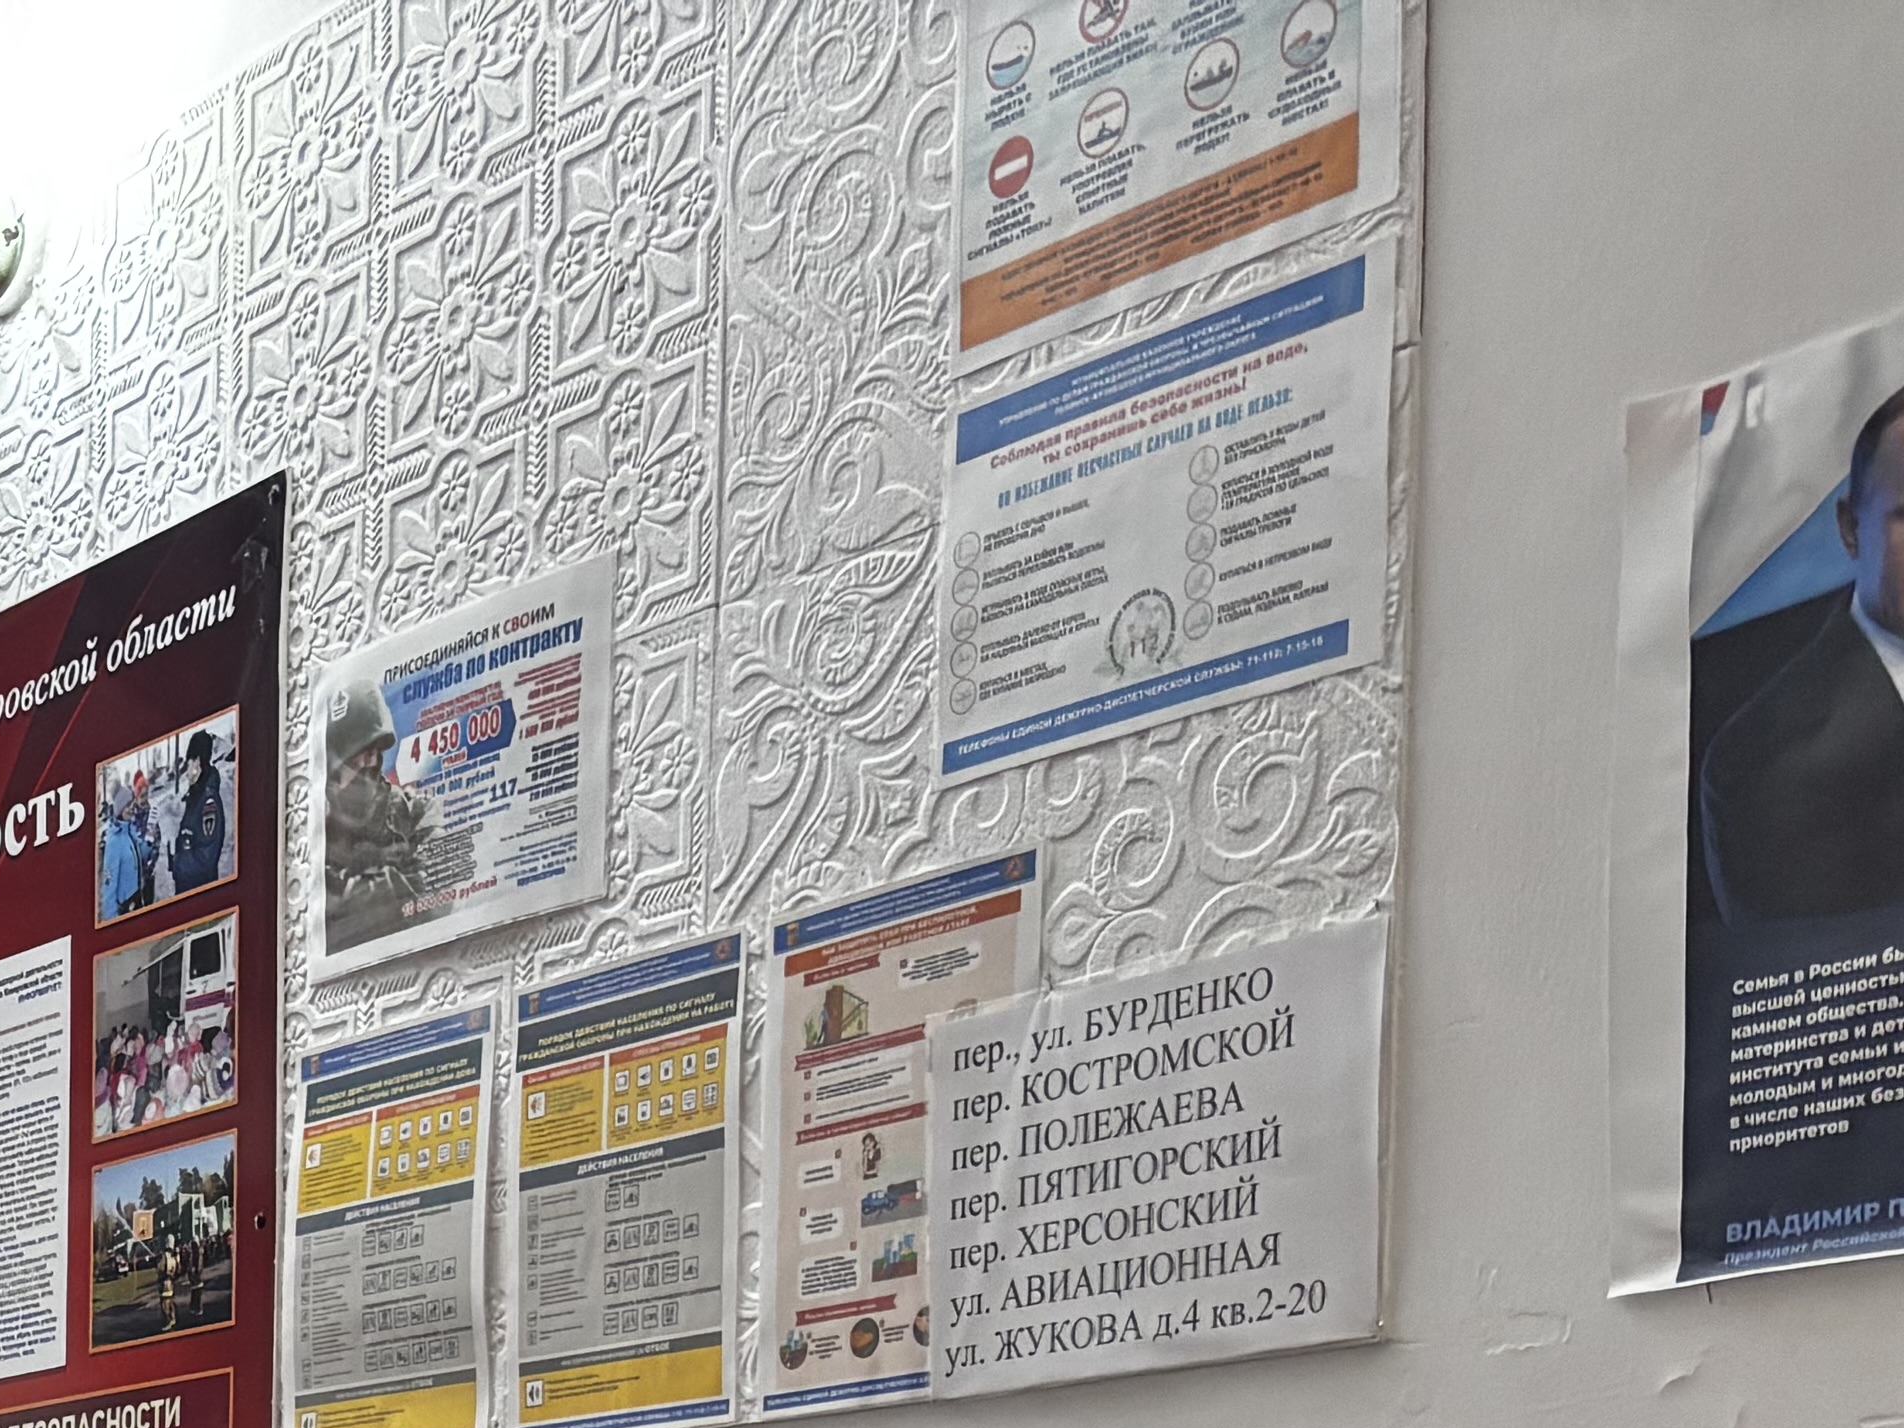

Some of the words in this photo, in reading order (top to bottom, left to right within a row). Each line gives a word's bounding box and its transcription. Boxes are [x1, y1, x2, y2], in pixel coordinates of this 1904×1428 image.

[991, 432, 1062, 470] Соблюдая
[1065, 411, 1127, 452] правила
[1130, 366, 1239, 418] безопасности
[1243, 358, 1263, 379] на
[1064, 418, 1147, 462] сохранишь
[106, 584, 237, 673] области
[383, 628, 489, 685] ПРИСОЕДИНЯЙСЯ
[492, 623, 501, 641] К
[503, 602, 555, 635] СВОИМ
[410, 736, 421, 764] 4
[428, 721, 461, 757] 450
[467, 704, 502, 745] 000
[490, 777, 518, 803] 117
[1732, 971, 1789, 996] Семья
[1794, 968, 1804, 984] в
[1809, 952, 1878, 981] России
[953, 1041, 1021, 1073] пер.,
[1030, 1024, 1073, 1063] ул.
[1084, 966, 1274, 1043] БУРДЕНКО
[1731, 988, 1806, 1019] высшей
[1731, 1014, 1802, 1042] камнем
[1806, 995, 1904, 1026] общества.
[952, 1091, 1010, 1124] пер.
[1021, 1004, 1295, 1108] КОСТРОМСКОЙ
[1729, 1053, 1824, 1086] института
[1828, 1043, 1888, 1068] семьи
[1730, 1027, 1849, 1063] материнства
[1854, 1023, 1867, 1040] и
[1729, 1078, 1817, 1108] молодым
[1821, 1075, 1833, 1091] и
[1730, 1113, 1740, 1130] в
[1744, 1099, 1799, 1127] числе
[1803, 1093, 1866, 1117] наших
[951, 1140, 1009, 1172] пер.
[1018, 1080, 1245, 1159] ПОЛЕЖАЕВА
[1729, 1117, 1850, 1153] приоритетов
[950, 1190, 1007, 1222] пер.
[1017, 1115, 1283, 1209] ПЯТИГОРСКИЙ
[949, 1239, 1006, 1271] пер.
[1016, 1173, 1260, 1260] ХЕРСОНСКИЙ
[1726, 1201, 1880, 1243] ВЛАДИМИР
[1724, 1242, 1808, 1266] Президент
[949, 1290, 991, 1328] ул.
[999, 1231, 1282, 1312] АВИАЦИОННАЯ
[944, 1340, 986, 1378] ул.
[994, 1309, 1143, 1364] ЖУКОВА
[1152, 1300, 1201, 1342] д.4
[1211, 1279, 1327, 1328] кв.2-20
